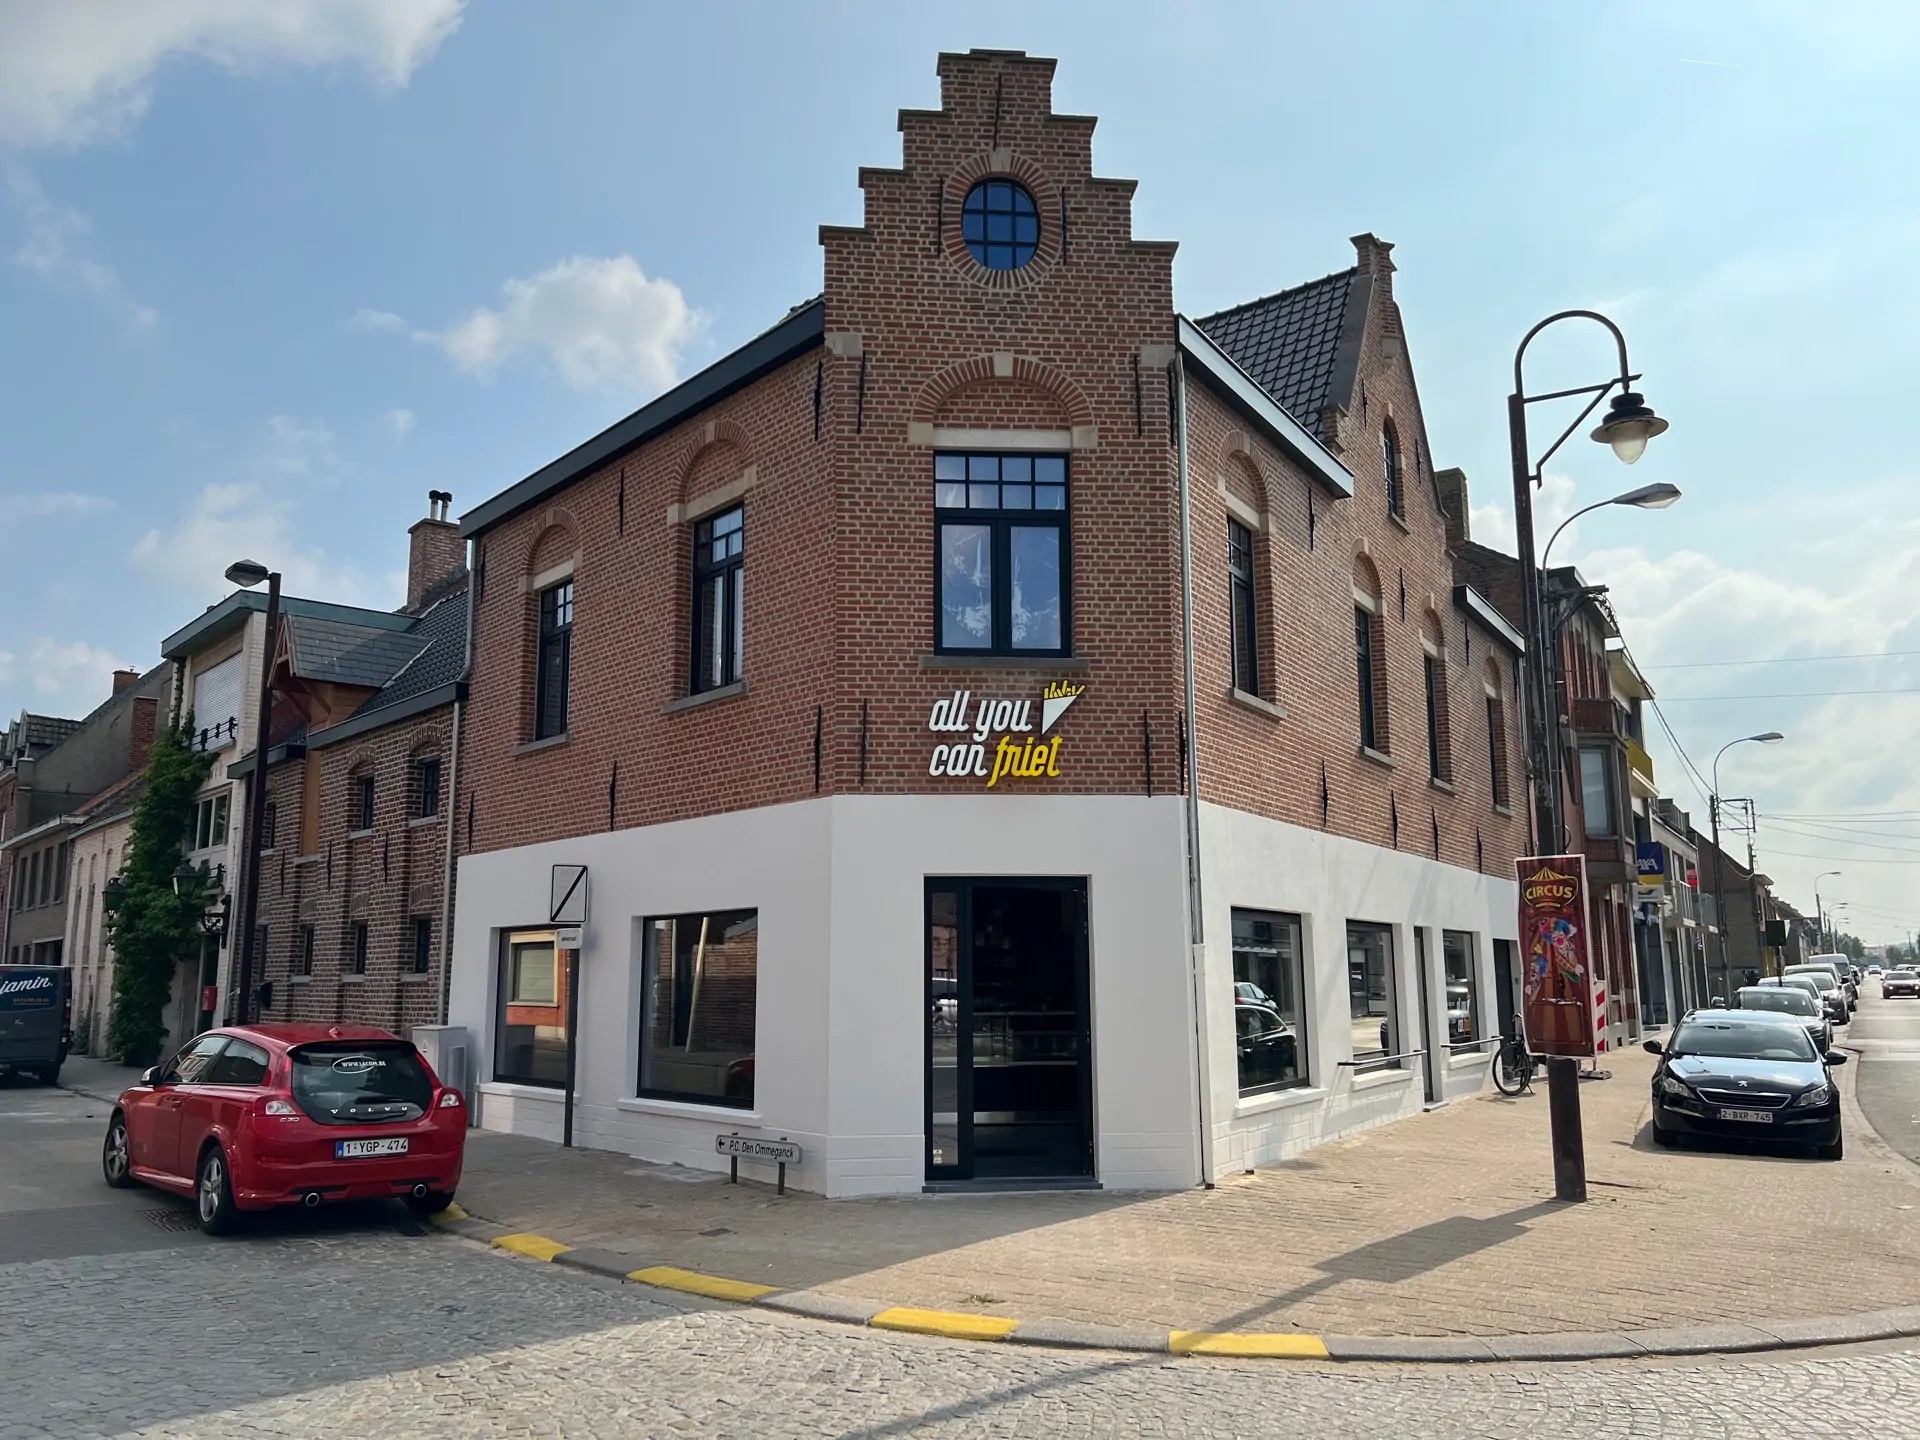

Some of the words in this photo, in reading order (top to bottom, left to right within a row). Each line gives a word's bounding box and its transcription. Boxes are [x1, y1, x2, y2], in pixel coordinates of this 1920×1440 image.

[929, 691, 970, 731] all
[973, 700, 1033, 742] you
[929, 744, 987, 776] can
[987, 735, 1063, 787] friet
[1526, 885, 1573, 899] CIRCUS
[330, 1106, 408, 1114] VOLVO
[742, 1142, 753, 1153] Den
[755, 1143, 794, 1159] Ommeganck
